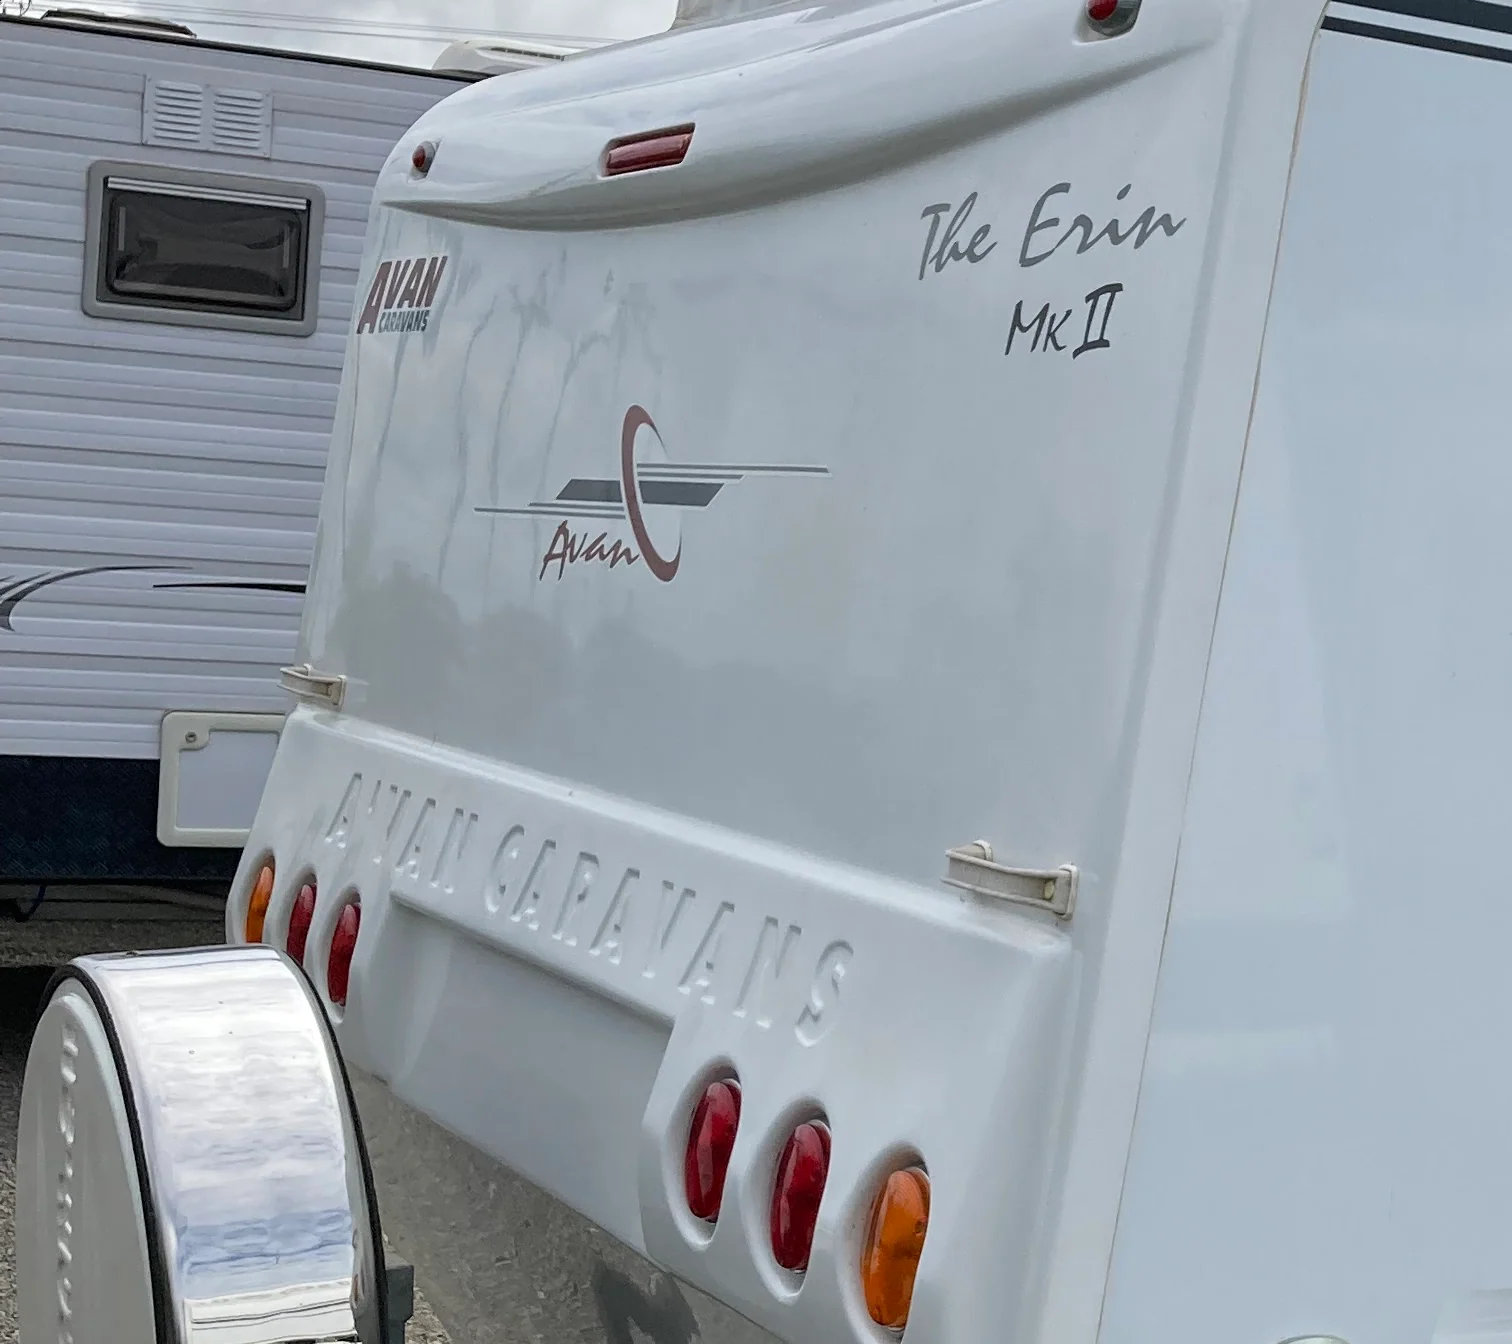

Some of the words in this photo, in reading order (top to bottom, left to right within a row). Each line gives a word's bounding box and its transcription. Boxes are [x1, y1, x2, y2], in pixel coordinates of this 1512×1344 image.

[918, 191, 998, 281] The
[1018, 182, 1188, 268] Erin
[356, 255, 448, 334] AVAN
[378, 308, 431, 333] CARAVANS
[539, 519, 640, 582] Avan
[485, 824, 855, 1048] CARAVANS
